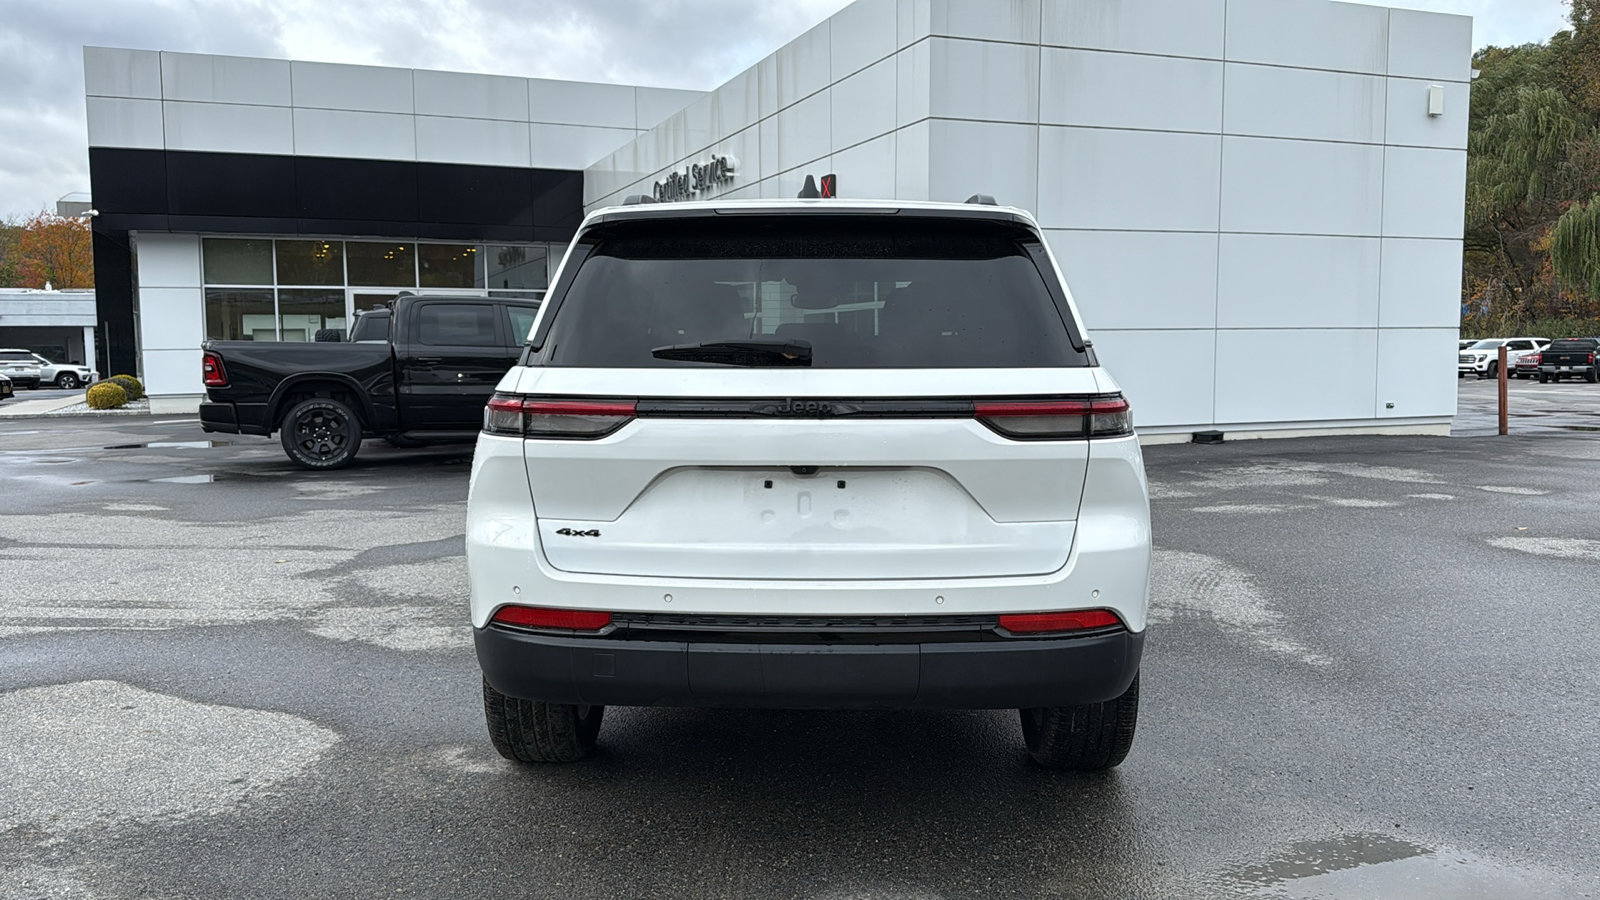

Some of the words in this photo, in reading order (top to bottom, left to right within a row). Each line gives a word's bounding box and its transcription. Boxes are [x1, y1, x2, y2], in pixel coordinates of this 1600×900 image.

[653, 166, 690, 202] Certified
[692, 154, 728, 190] Service
[778, 398, 832, 416] Jeep
[555, 528, 602, 537] 4x4
